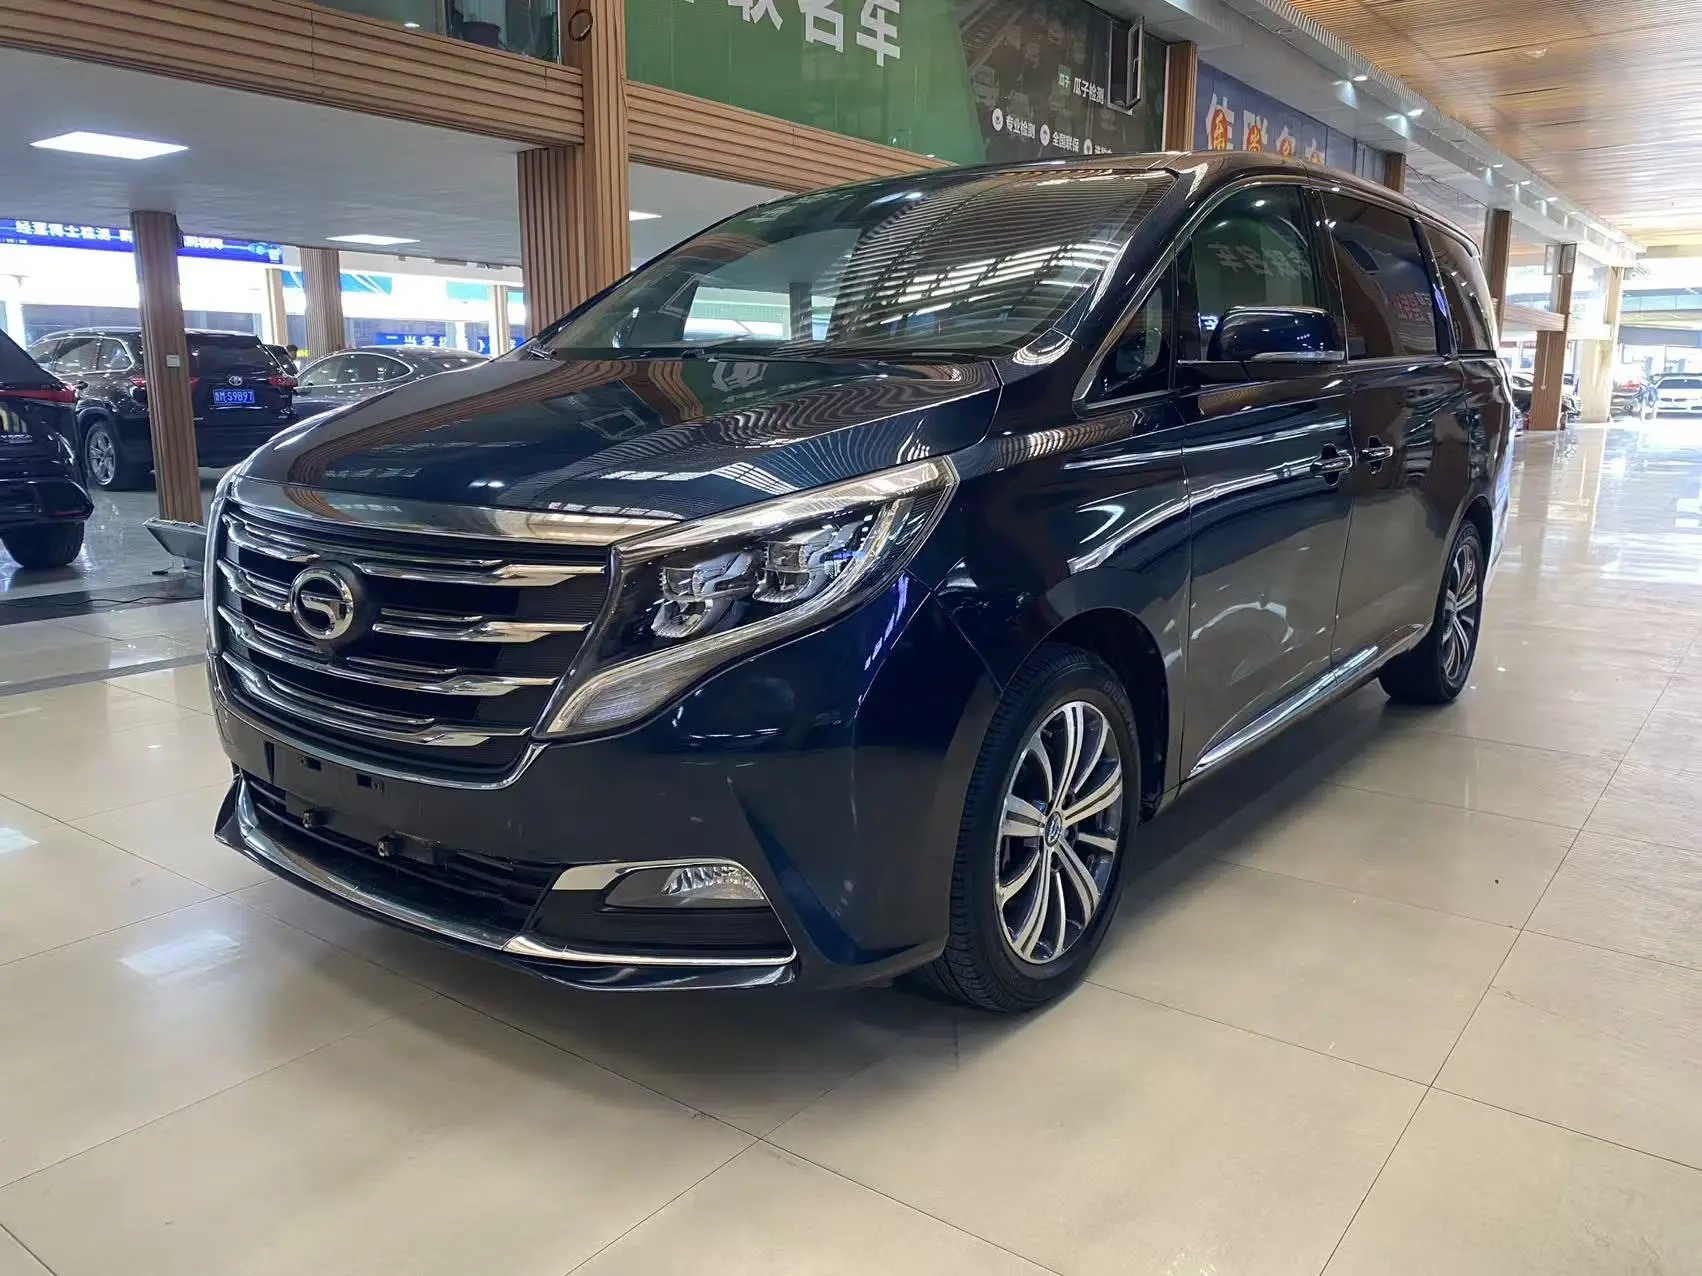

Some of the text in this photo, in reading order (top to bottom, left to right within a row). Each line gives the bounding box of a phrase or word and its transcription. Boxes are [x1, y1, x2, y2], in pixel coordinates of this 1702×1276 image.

[1073, 77, 1104, 104] 瓜子检测
[1006, 115, 1035, 139] 专业检测
[1052, 131, 1080, 153] 全国联保
